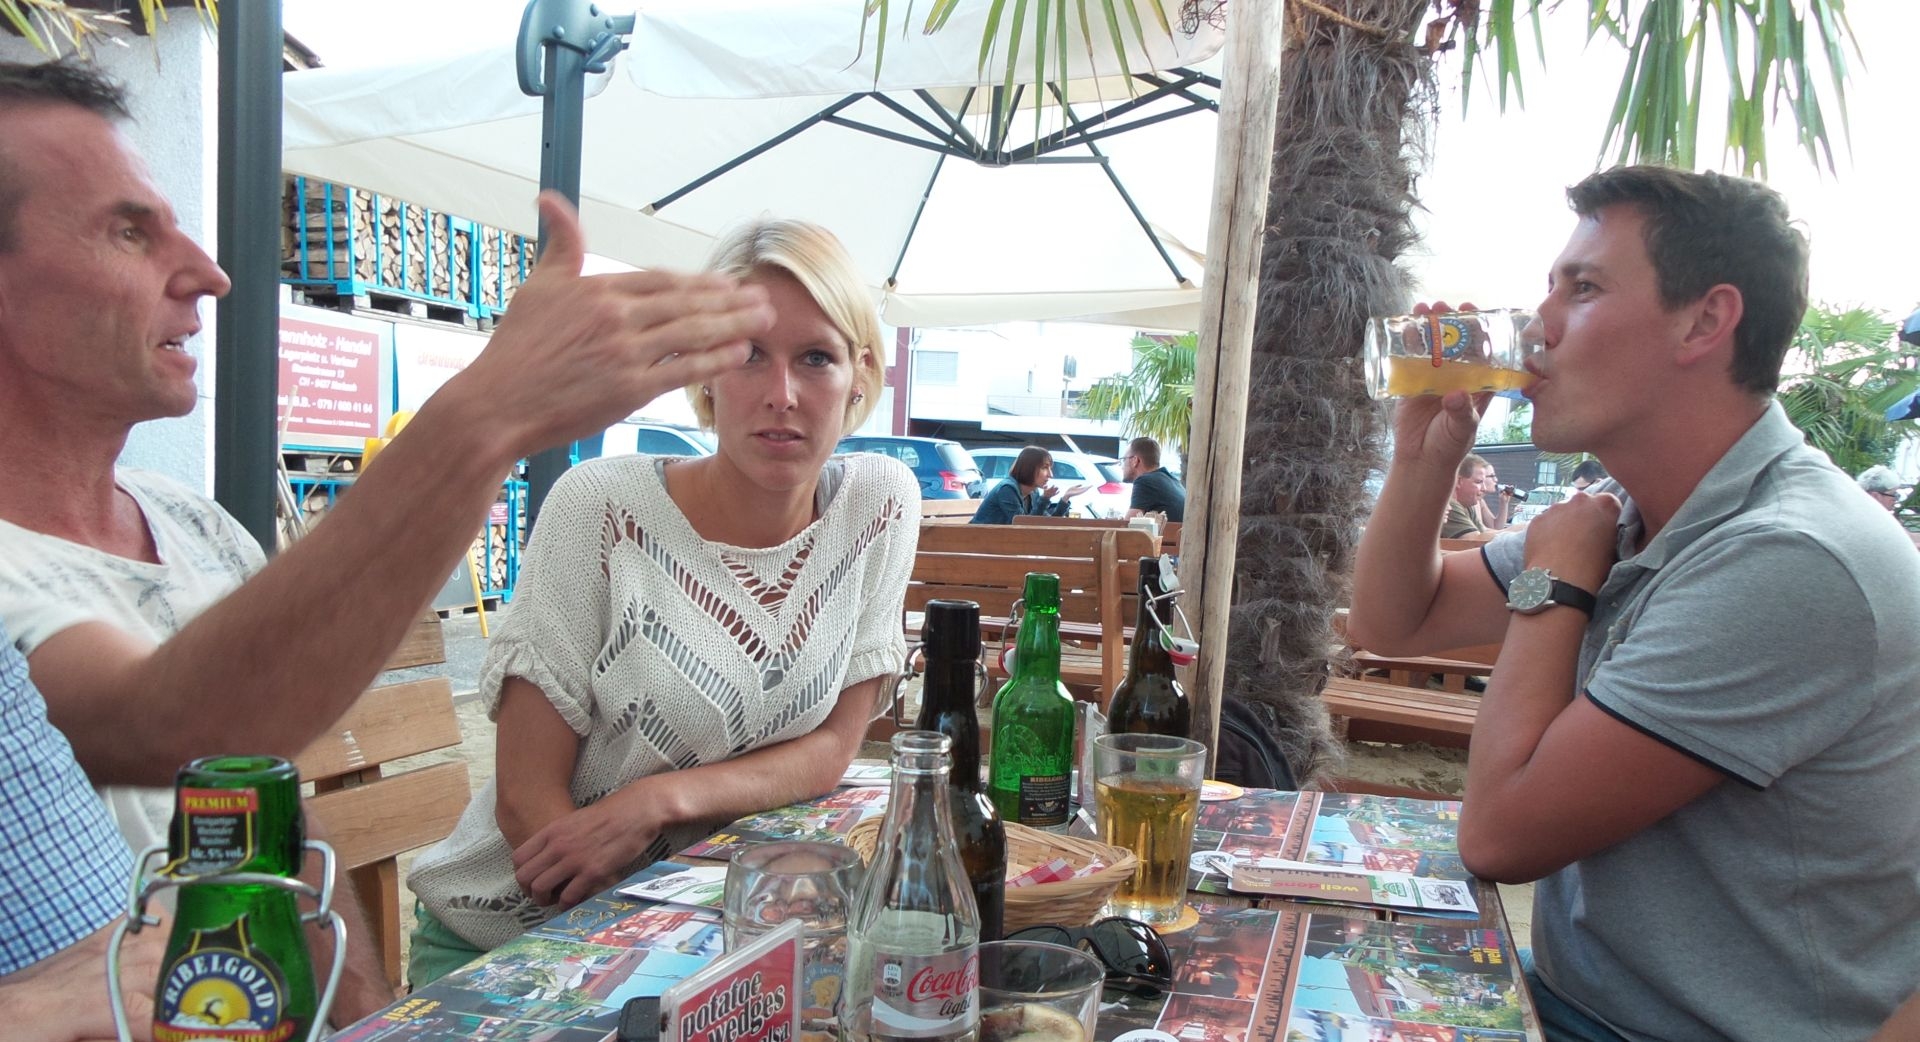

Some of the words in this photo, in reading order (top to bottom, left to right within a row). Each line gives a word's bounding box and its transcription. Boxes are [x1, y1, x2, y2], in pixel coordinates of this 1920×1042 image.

[279, 329, 328, 349] rennholz
[184, 796, 249, 810] PREMIUM
[164, 953, 276, 1009] RIBELGOLD
[681, 970, 762, 1042] potatoe
[706, 984, 786, 1042] wedges
